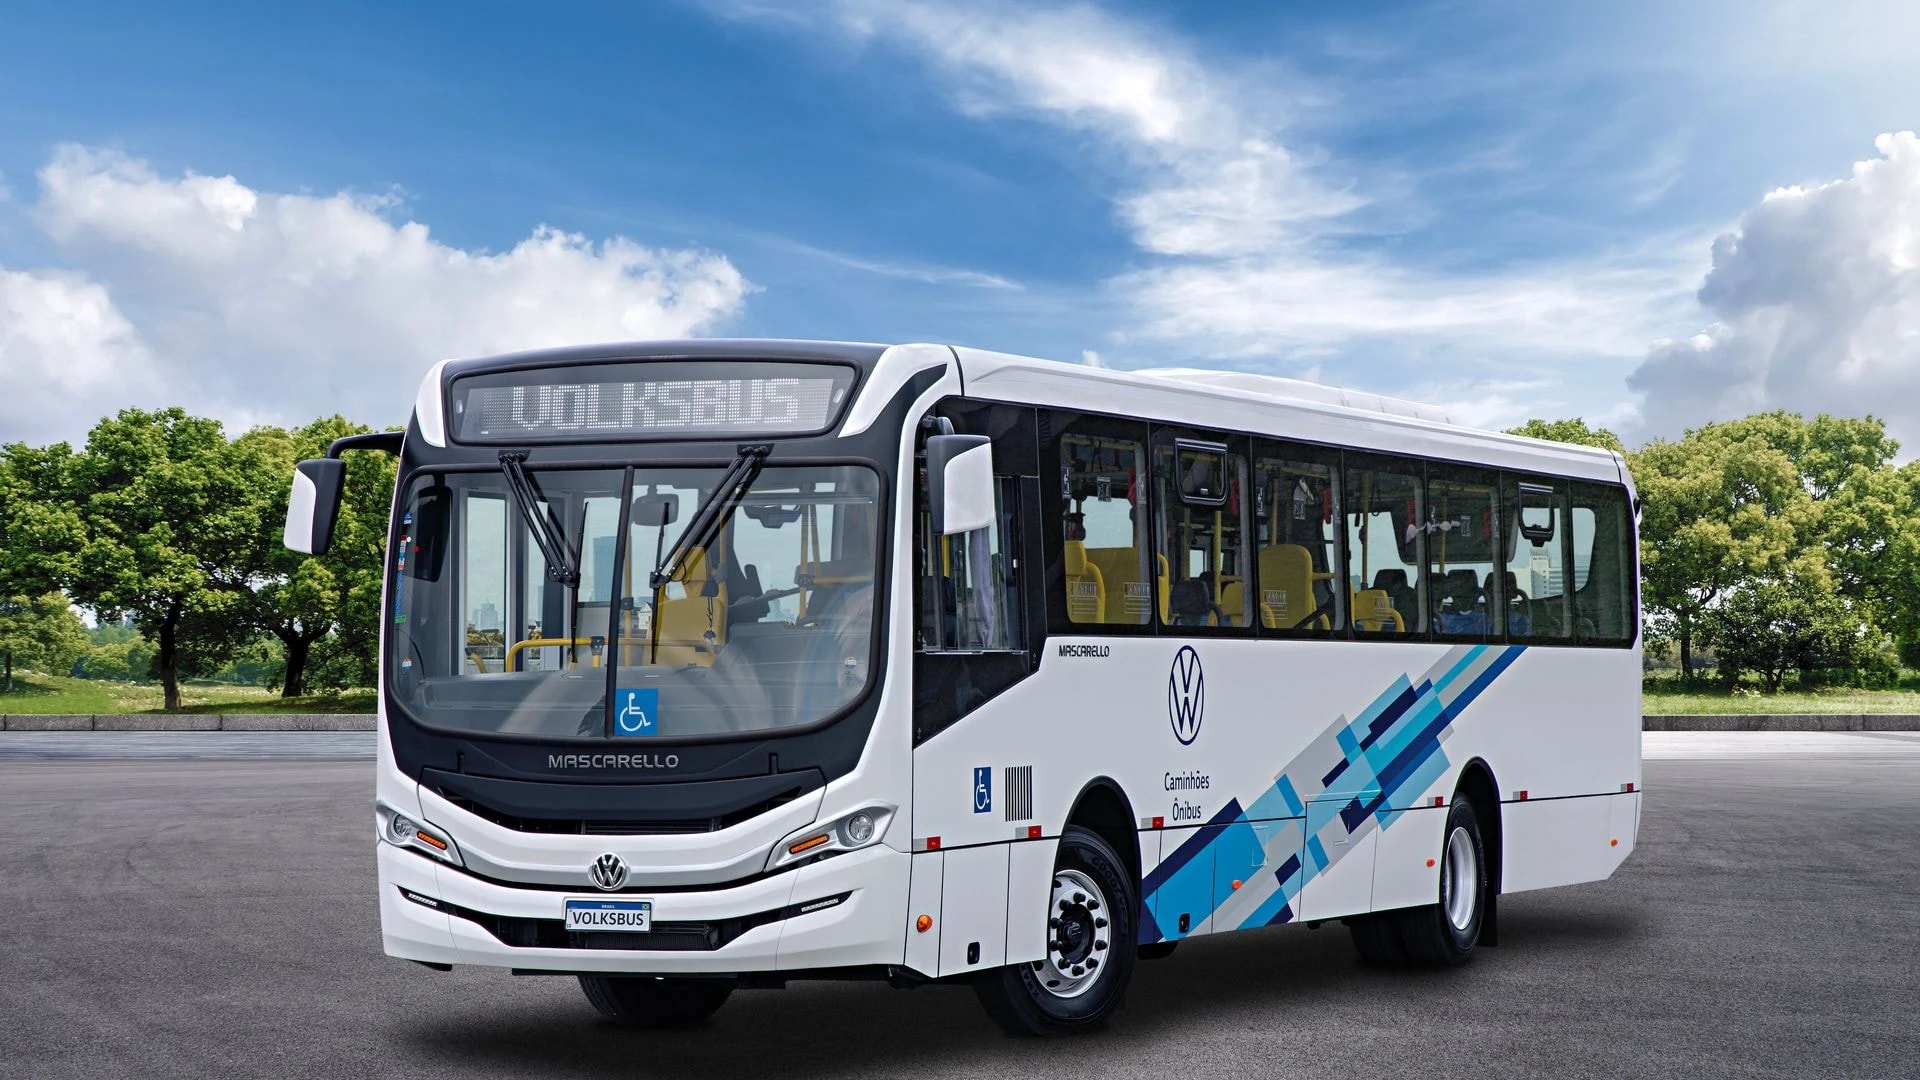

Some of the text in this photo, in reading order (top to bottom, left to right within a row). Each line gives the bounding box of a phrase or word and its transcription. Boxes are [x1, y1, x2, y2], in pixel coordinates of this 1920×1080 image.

[512, 378, 800, 431] VOLKSBUS
[1058, 645, 1110, 657] MASCARELLO
[548, 754, 679, 769] MASCARELLO
[1164, 770, 1210, 792] Caminhões
[1172, 797, 1202, 821] Ônibus
[573, 911, 645, 926] VOLKSBUS
